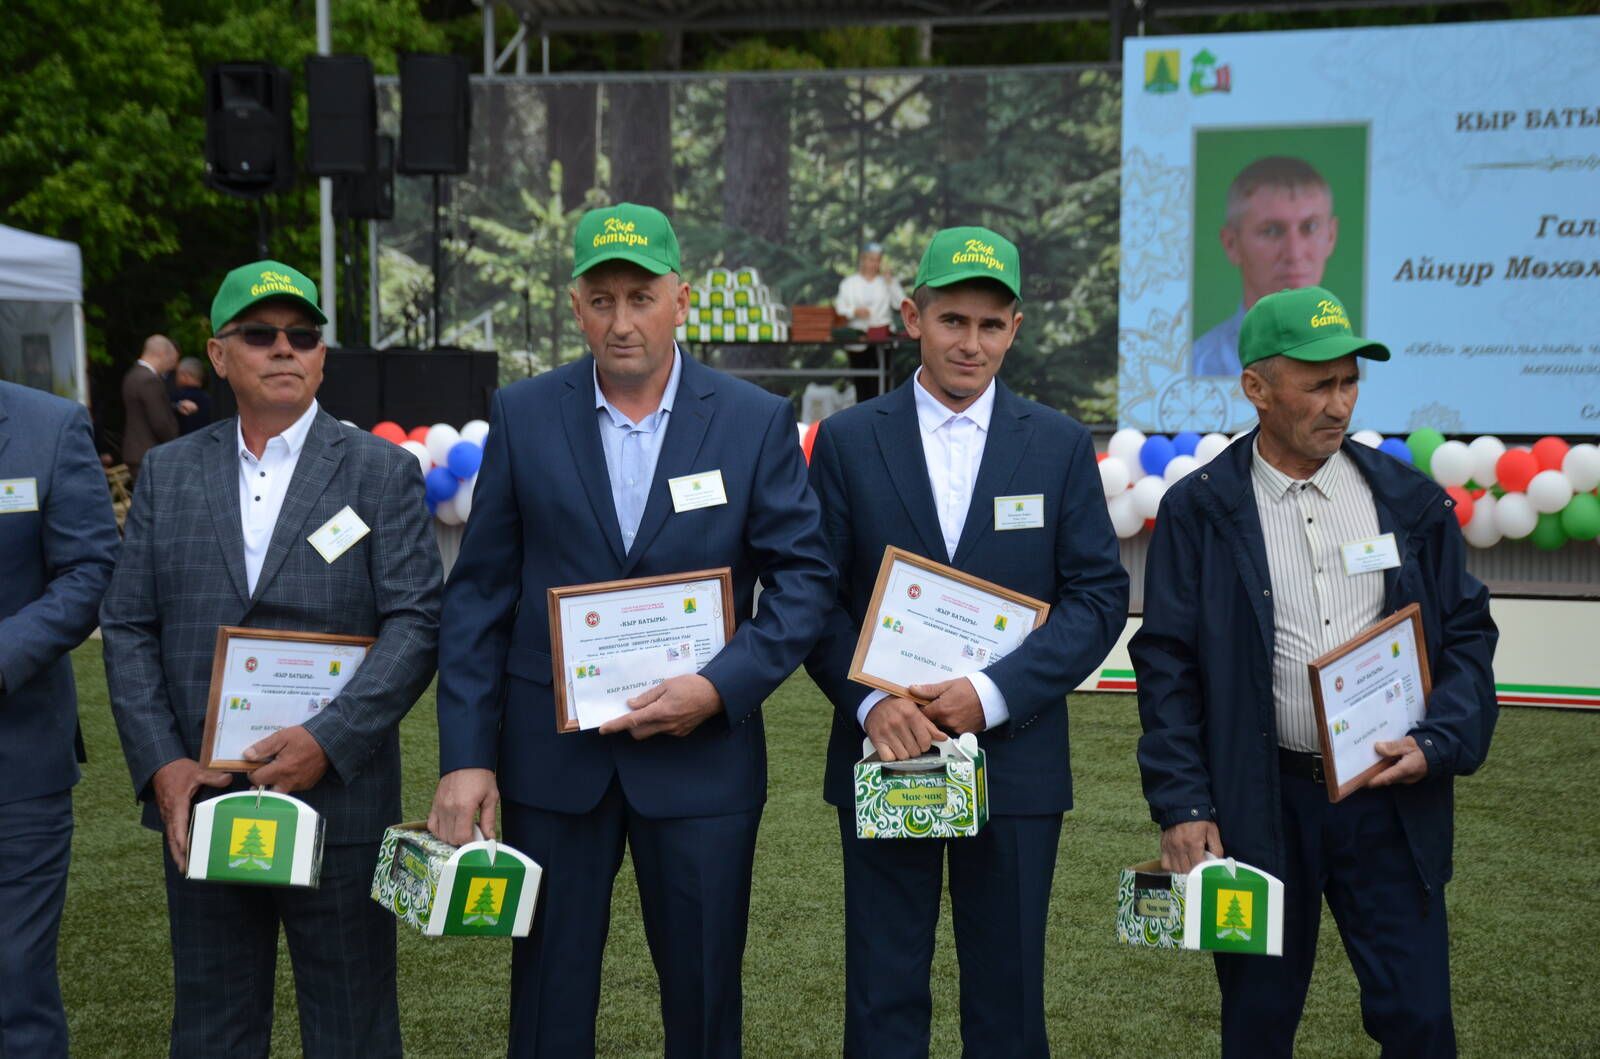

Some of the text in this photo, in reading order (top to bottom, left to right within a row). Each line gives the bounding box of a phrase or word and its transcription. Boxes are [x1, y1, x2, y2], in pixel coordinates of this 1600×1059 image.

[1456, 111, 1517, 132] КЫР
[1535, 214, 1600, 238] Гал
[593, 233, 648, 248] батыры
[952, 251, 1005, 271] батыры
[1394, 256, 1494, 286] Айнур
